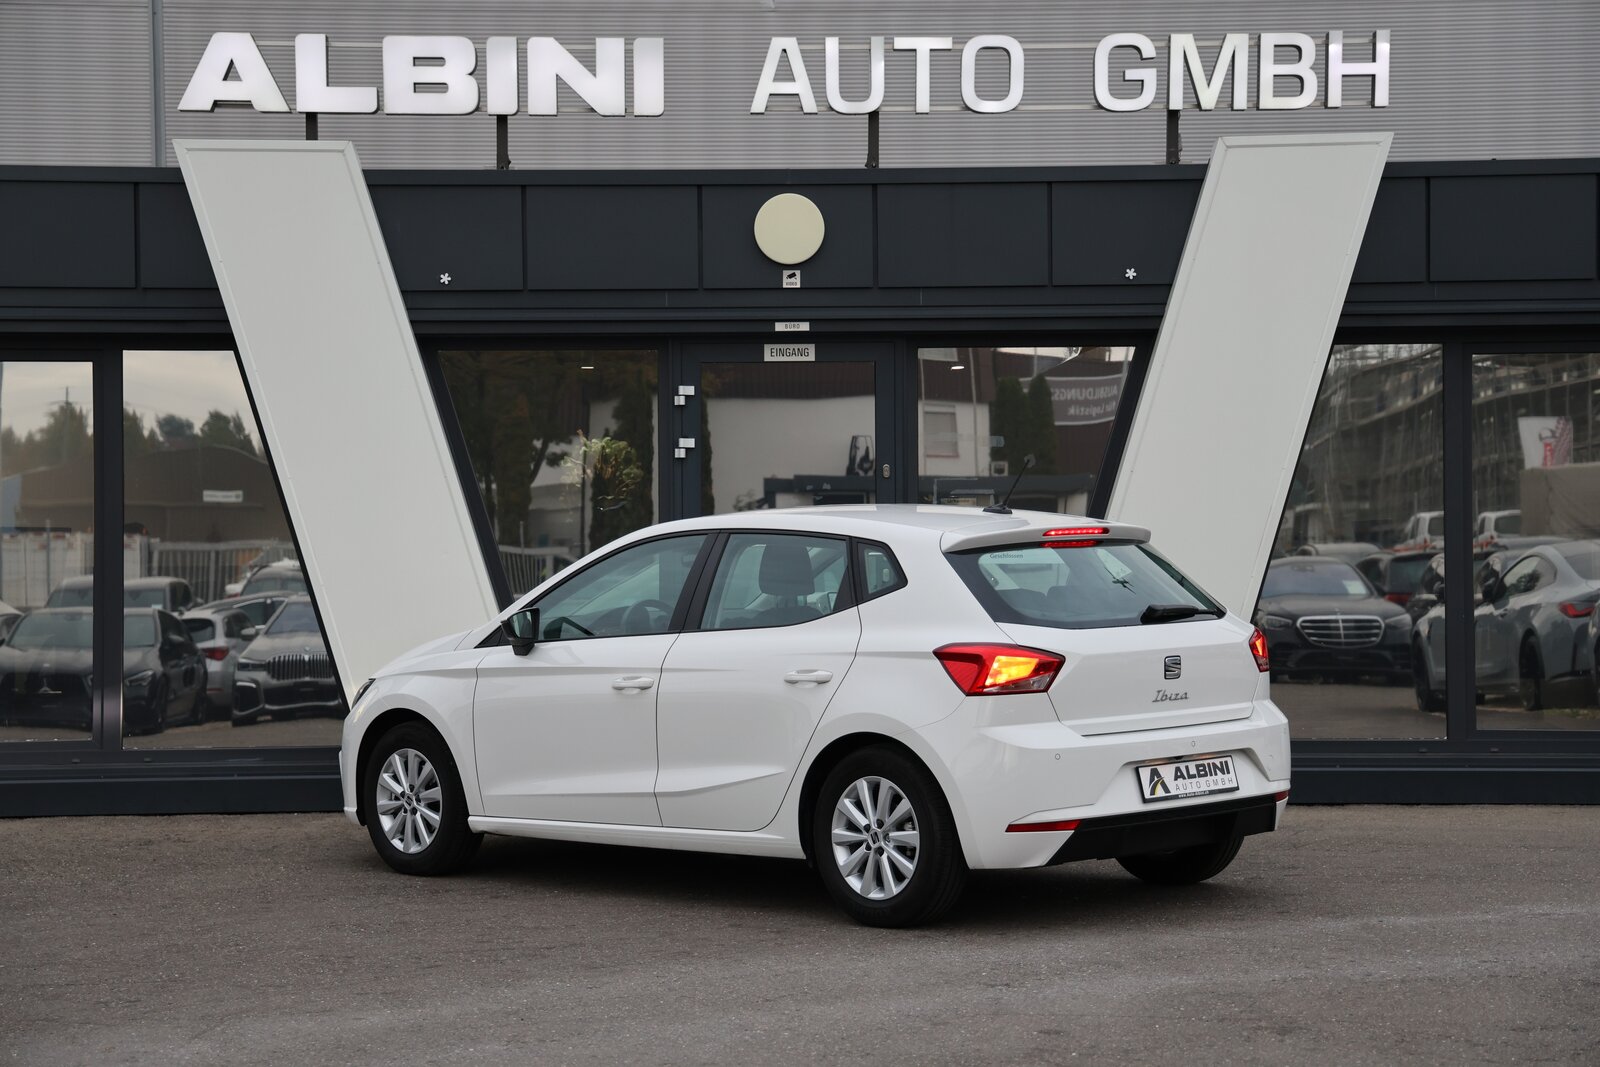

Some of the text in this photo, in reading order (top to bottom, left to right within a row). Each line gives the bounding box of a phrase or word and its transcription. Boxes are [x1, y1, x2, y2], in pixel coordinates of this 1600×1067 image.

[177, 29, 1391, 117] ALBINI AUTO GMBH
[770, 347, 810, 358] EINGANG
[1152, 689, 1190, 703] Ibiza
[1174, 760, 1230, 781] ALBINI
[1175, 777, 1234, 792] AUTO GMBH
